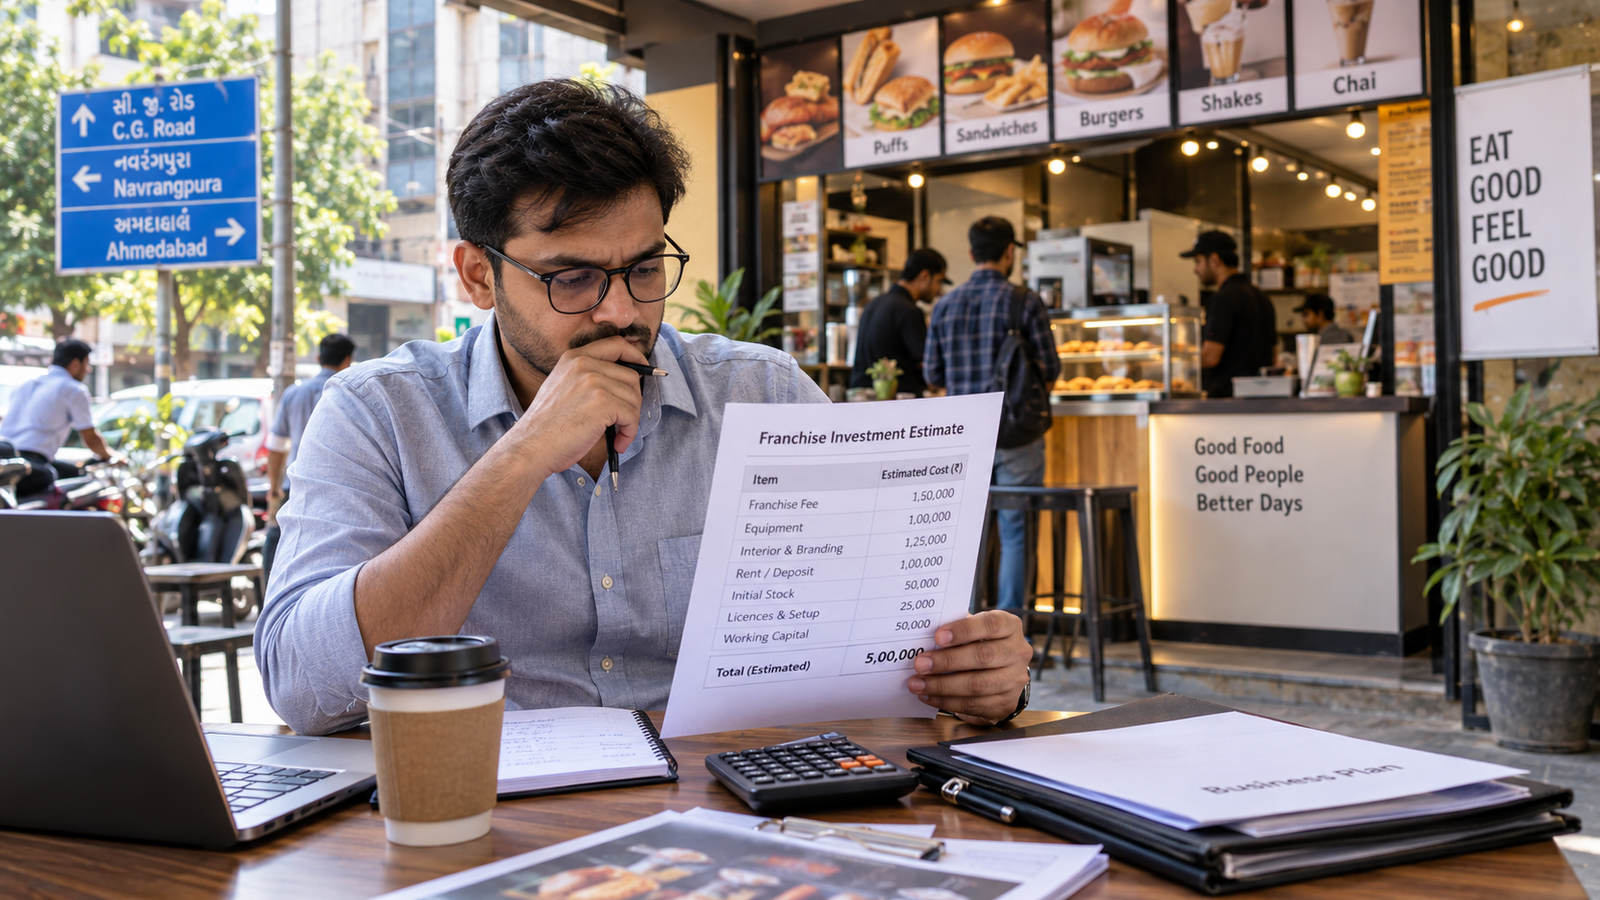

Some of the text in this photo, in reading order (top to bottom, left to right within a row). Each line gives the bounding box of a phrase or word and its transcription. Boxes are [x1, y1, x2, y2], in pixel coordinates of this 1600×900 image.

[1333, 71, 1376, 94] Chai
[170, 88, 195, 111] રોડ
[1201, 90, 1263, 112] Shakes
[1079, 106, 1144, 128] Burgers
[113, 116, 195, 140] C.G. Road
[957, 120, 1038, 143] Sandwiches
[873, 138, 908, 155] Puffs
[1470, 130, 1513, 165] EAT
[114, 178, 222, 200] Navrangpura
[1470, 166, 1542, 204] GOOD
[1472, 209, 1531, 244] FEEL
[106, 237, 207, 261] Ahmedabad
[1472, 248, 1545, 283] GOOD
[759, 423, 964, 445] Franchise Investment Estimate
[1195, 436, 1284, 455] Good Food
[753, 475, 778, 485] Item
[882, 463, 963, 480] Estimated Cost (₹)
[1196, 464, 1303, 487] Good People
[912, 488, 955, 502] 1,50,000
[749, 499, 819, 510] Franchise Fee
[1197, 494, 1302, 516] Better Days
[909, 511, 951, 525] 1,00,000
[745, 523, 803, 536] Equipment
[741, 543, 844, 556] Interior & Branding
[905, 534, 947, 548] 1,25,000
[900, 556, 943, 570] 1,00,000
[736, 567, 814, 579] Rent / Deposit
[905, 578, 939, 591] 50,000
[732, 589, 795, 600] Initial Stock
[900, 599, 935, 611] 25,000
[728, 609, 820, 622] Licences & Setup
[895, 619, 931, 631] 50,000
[724, 629, 809, 644] Working Capital
[717, 661, 811, 678] Total (Estimated)
[1201, 763, 1403, 794] Business Plan
